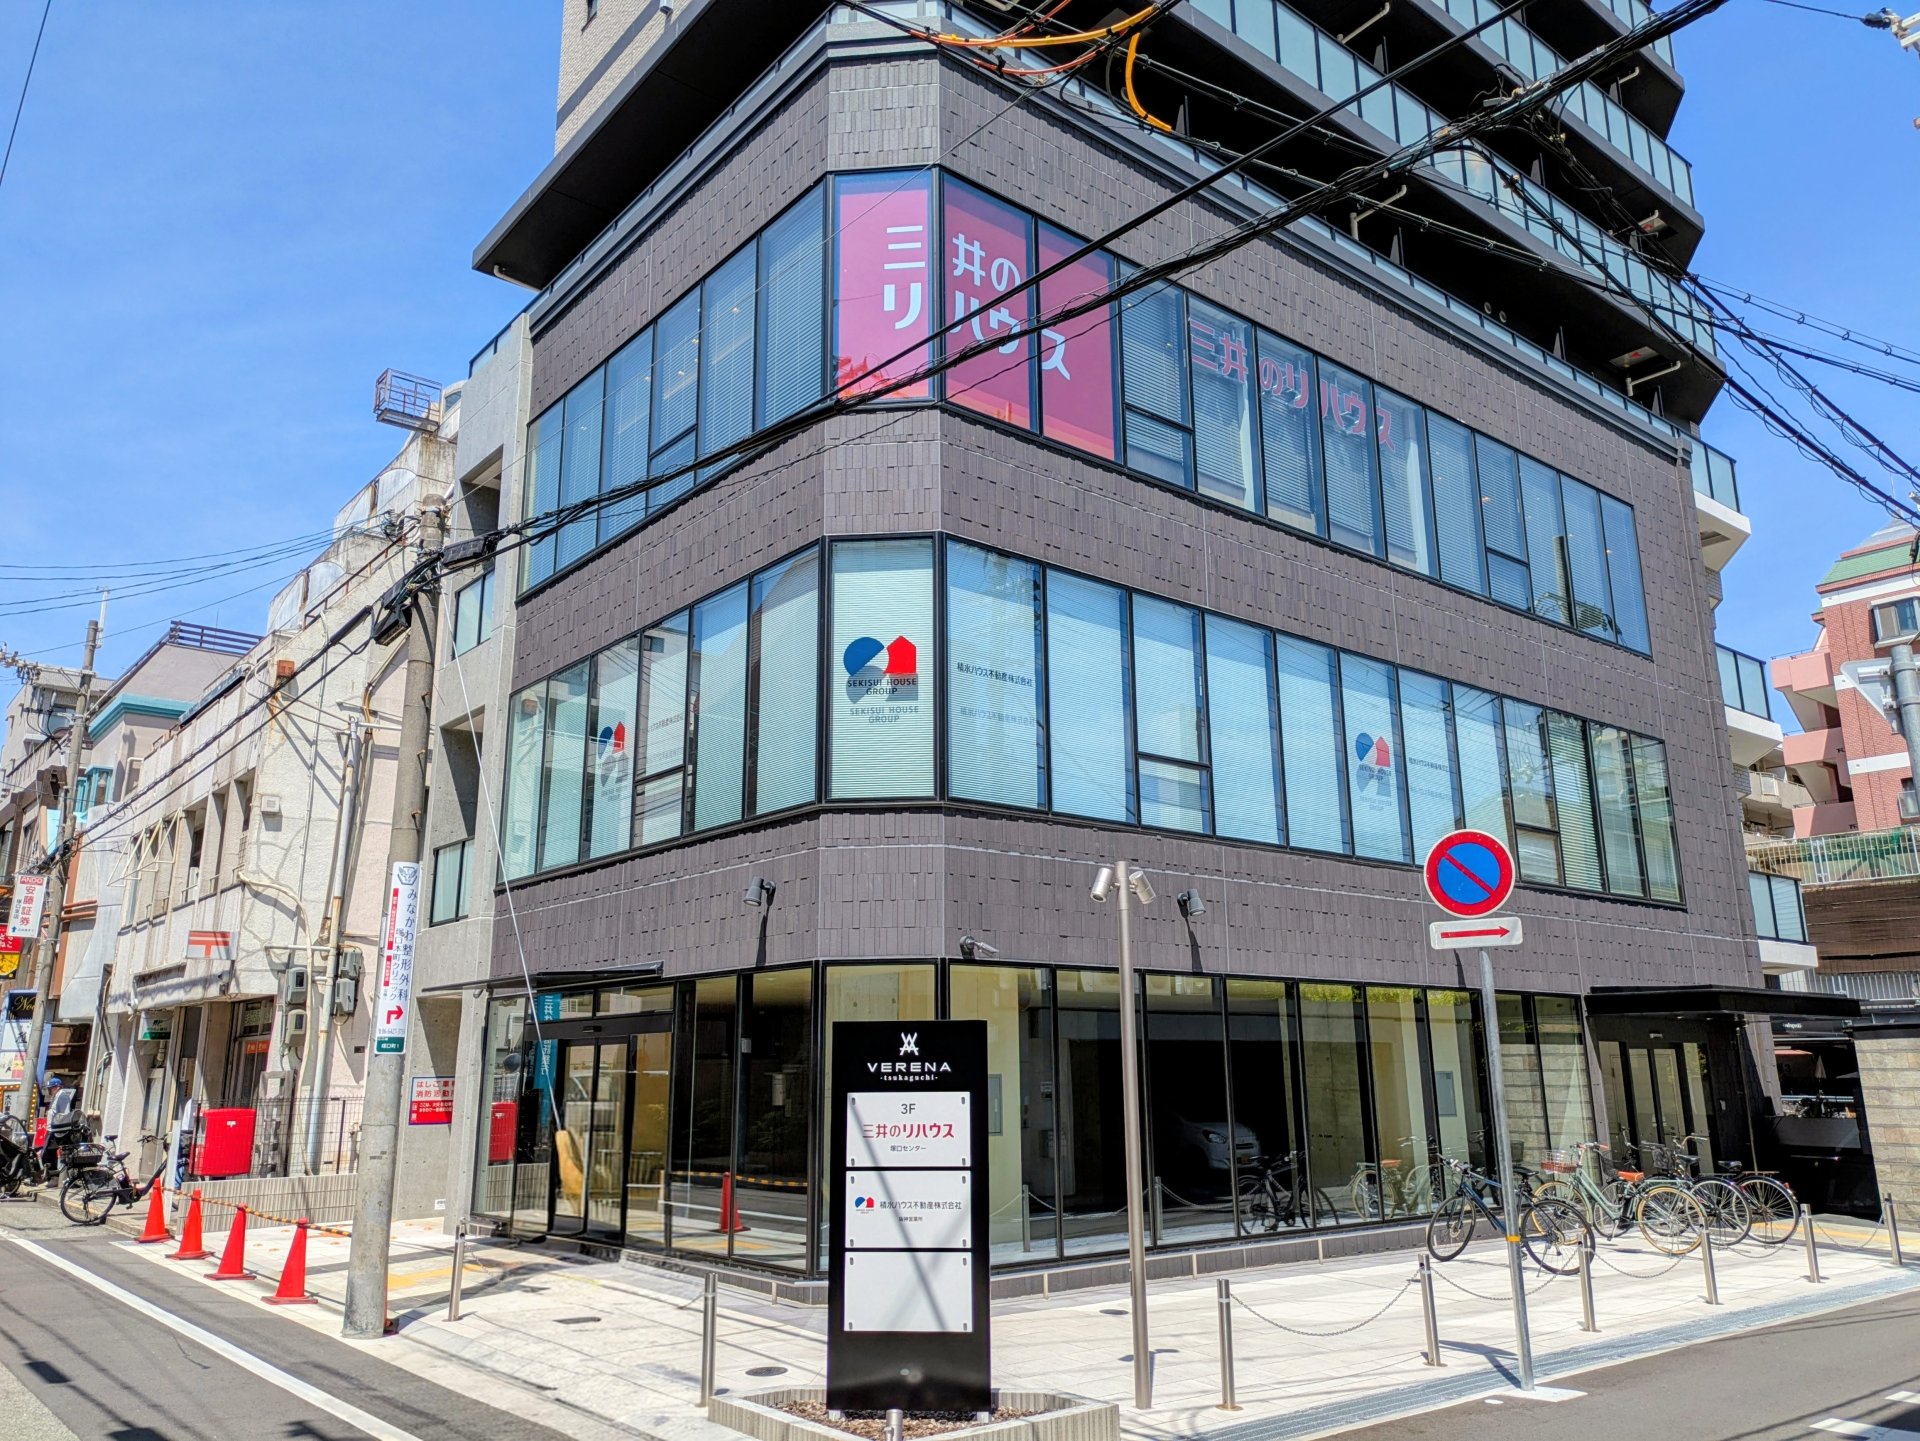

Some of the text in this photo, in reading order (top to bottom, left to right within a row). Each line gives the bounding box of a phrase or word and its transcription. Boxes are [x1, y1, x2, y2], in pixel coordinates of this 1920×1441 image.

[884, 225, 1021, 293] 三井の
[882, 281, 1071, 381] リハウス
[1190, 320, 1396, 451] 三井のリハウス
[848, 678, 917, 687] SEKISUI HOUSE
[866, 687, 898, 695] GROUP
[21, 876, 43, 884] ANDO
[19, 885, 36, 926] 安藤証券
[867, 1062, 952, 1073] VERENA
[901, 1103, 916, 1114] 3F
[862, 1123, 955, 1139] 三井のリハウス
[880, 1201, 962, 1210] 積水ハウス不動産株式会社
